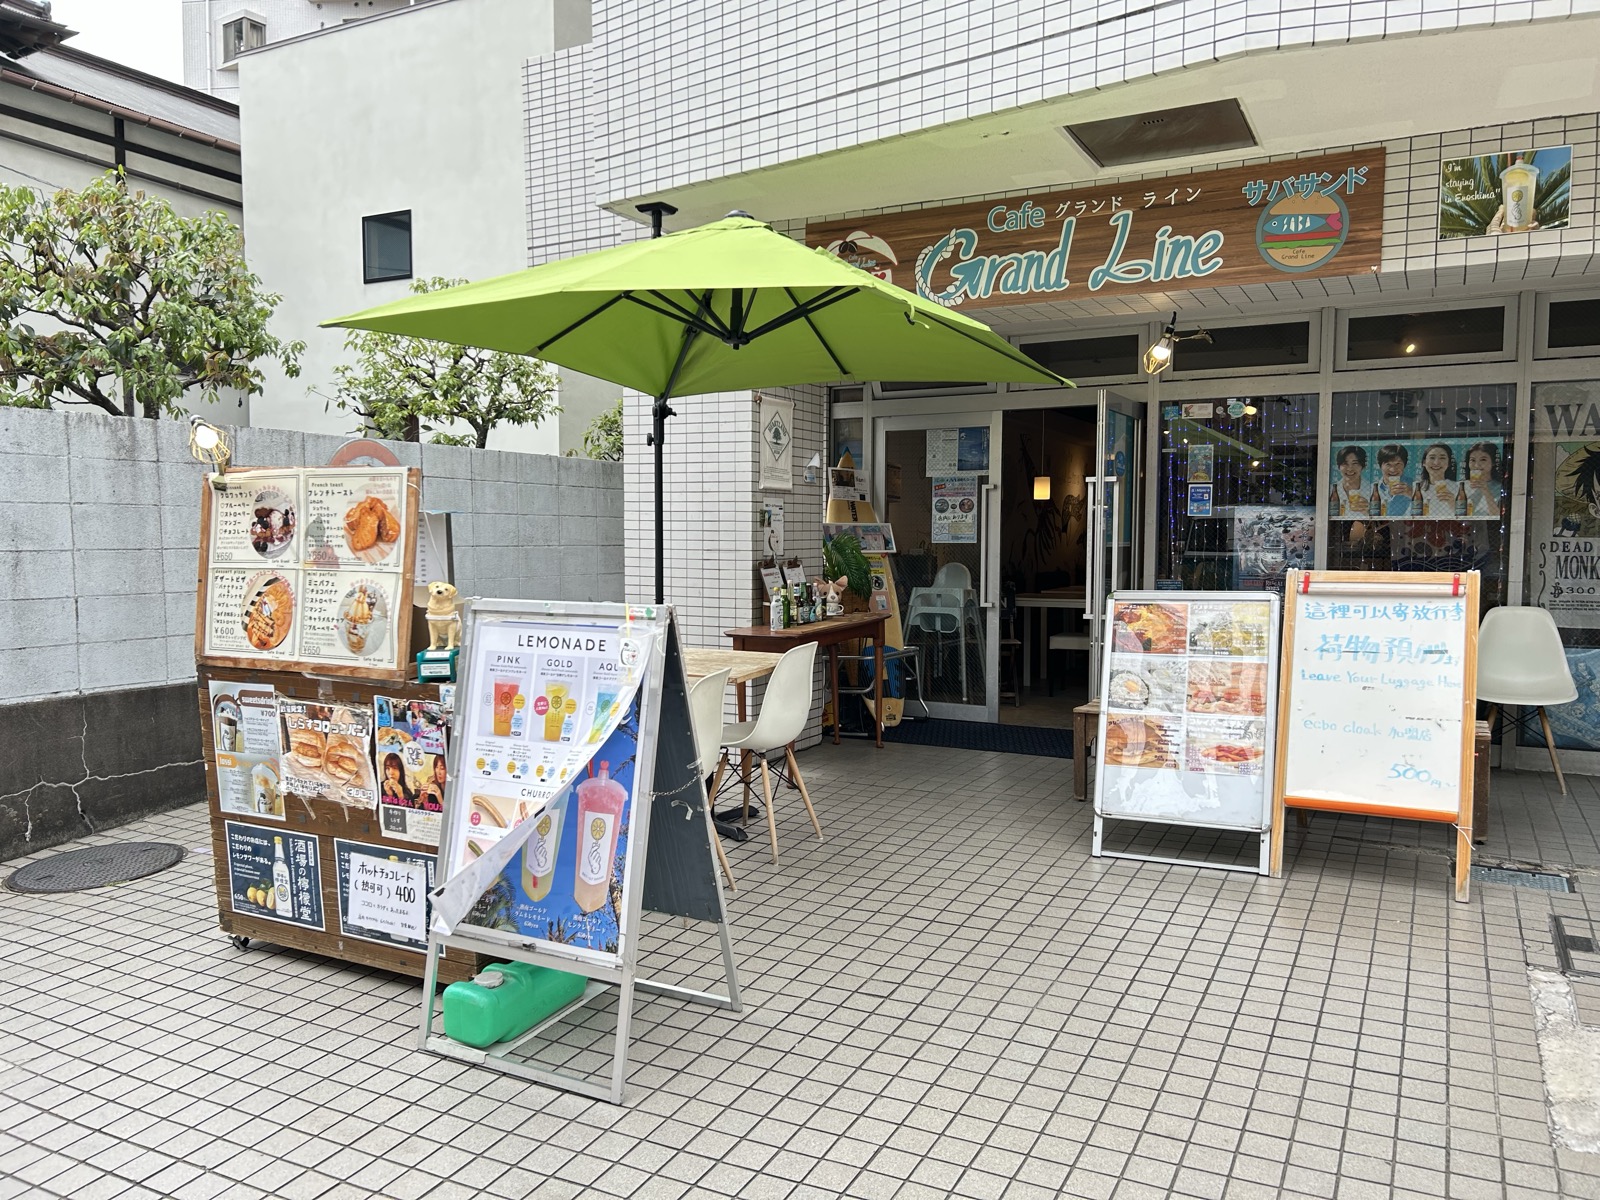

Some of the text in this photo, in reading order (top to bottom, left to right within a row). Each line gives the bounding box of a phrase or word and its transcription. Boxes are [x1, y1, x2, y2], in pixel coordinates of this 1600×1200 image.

[1446, 163, 1462, 173] I'm
[1242, 165, 1369, 206] サバサンド
[1446, 178, 1475, 191] staying
[1055, 187, 1203, 219] グランド ライン
[987, 200, 1046, 232] Cafe
[1282, 215, 1311, 233] SABA
[915, 209, 1226, 307] Grand Line
[308, 490, 354, 498] フレンチトースト
[1549, 541, 1594, 553] DEAD
[214, 575, 247, 583] デザートピザ
[308, 579, 335, 587] ミニパフェ
[1304, 602, 1464, 622] 這裡可以寄放行李
[214, 626, 235, 636] ¥600
[303, 645, 321, 656] ¥650
[517, 635, 607, 652] LEMONADE
[497, 656, 521, 664] PINK
[547, 659, 573, 668] GOLD
[1301, 668, 1342, 682] Leave
[1347, 670, 1378, 684] Your
[294, 838, 312, 922] 酒場の檸檬堂
[358, 861, 414, 884] ホットチョコレート
[395, 885, 416, 904] 400
